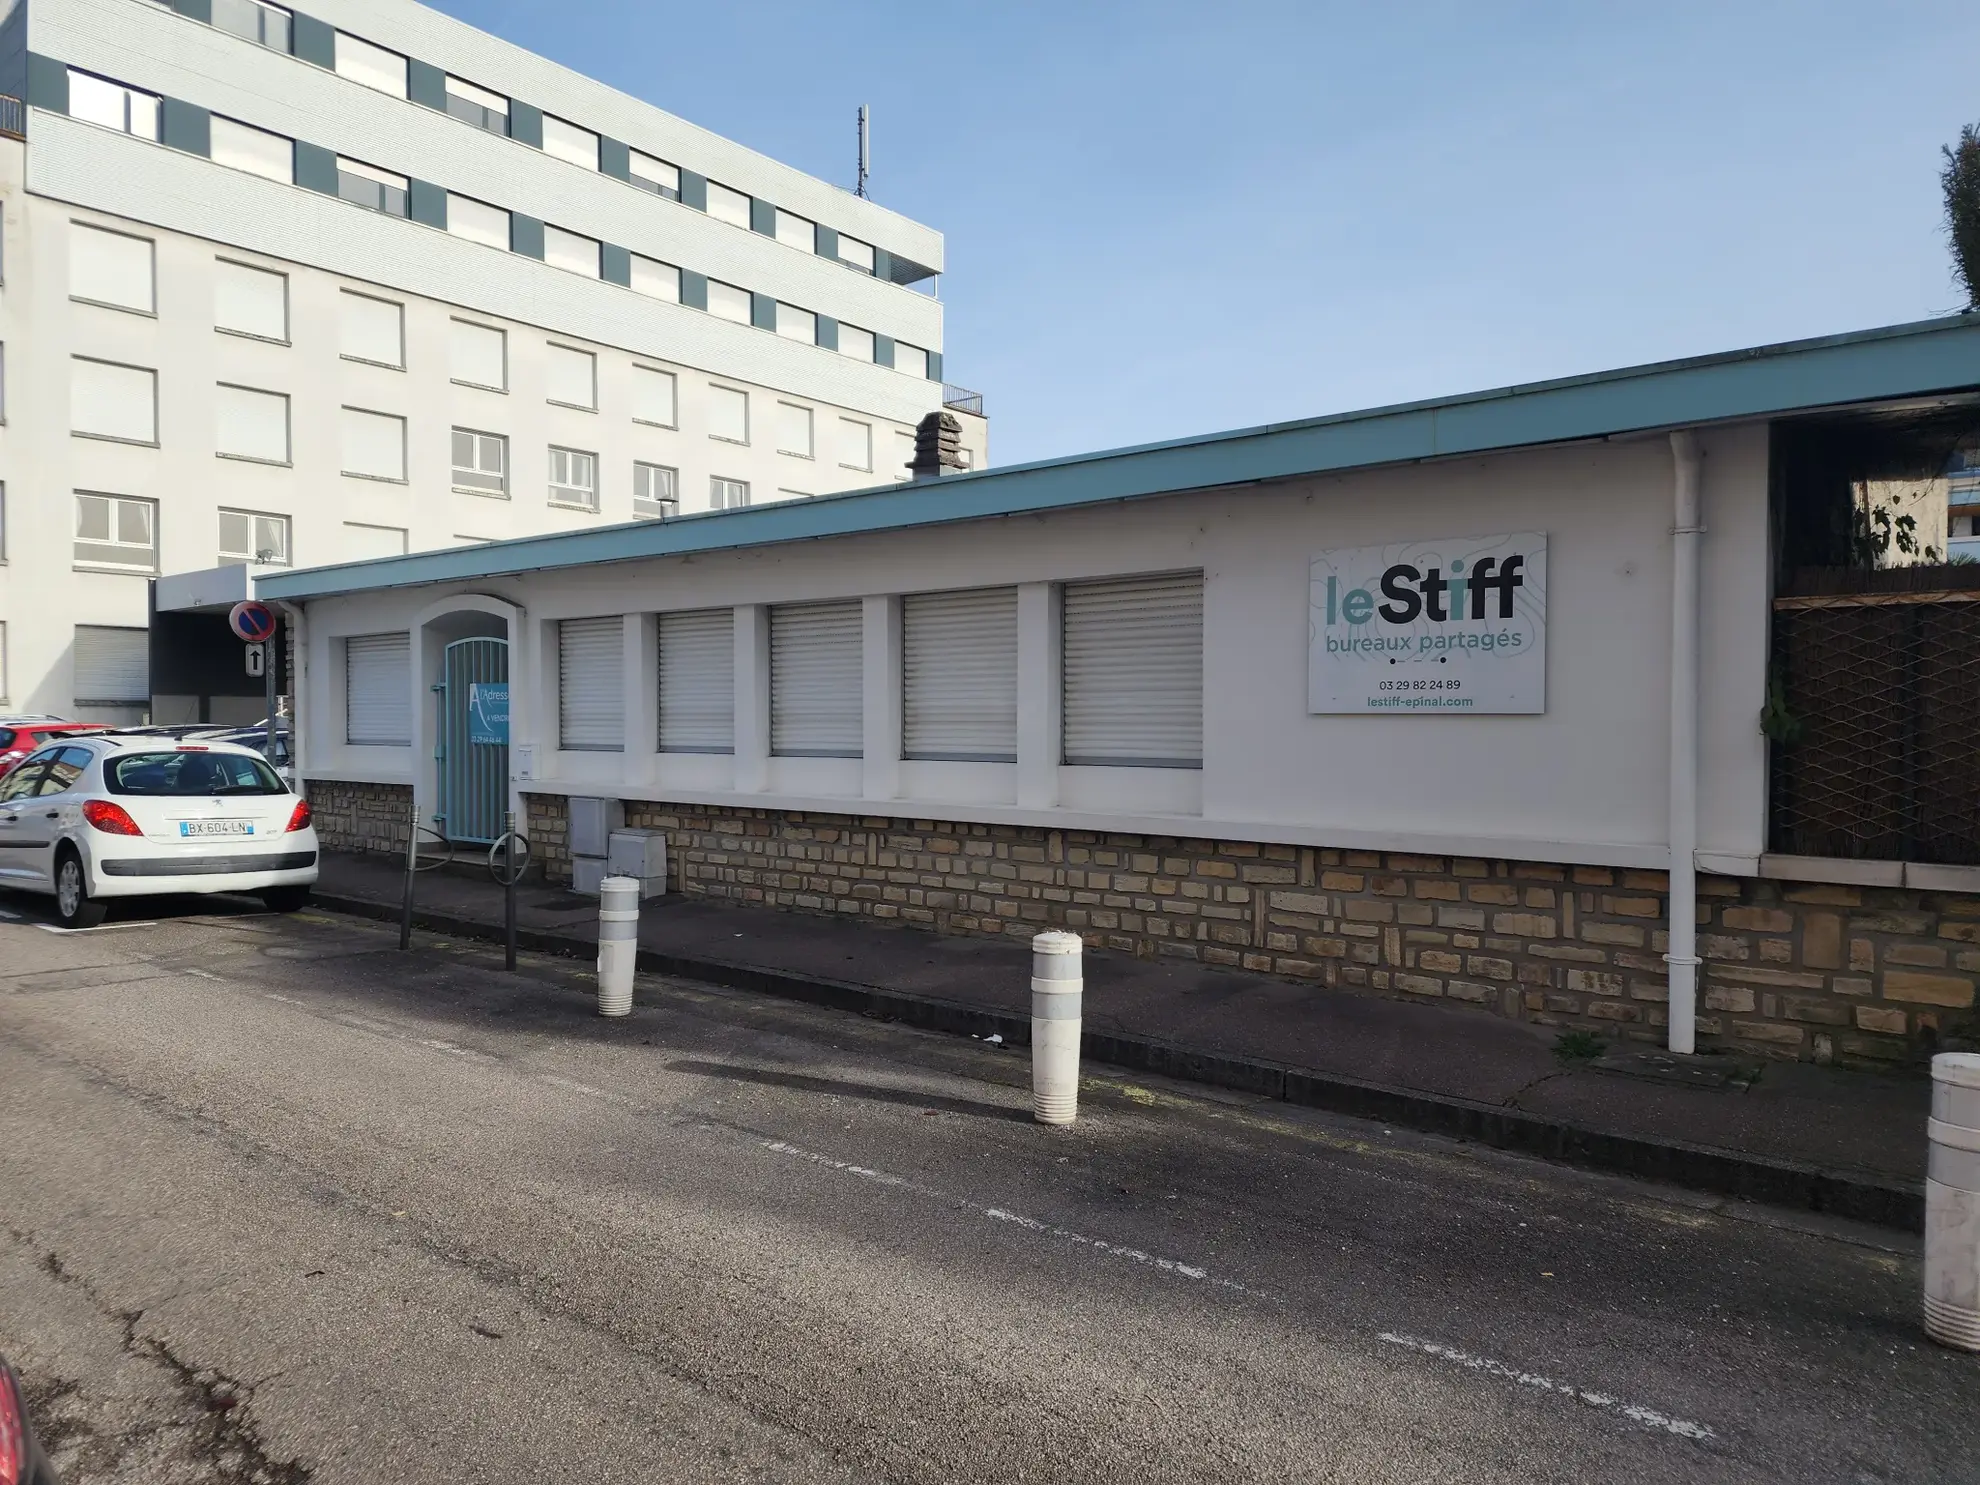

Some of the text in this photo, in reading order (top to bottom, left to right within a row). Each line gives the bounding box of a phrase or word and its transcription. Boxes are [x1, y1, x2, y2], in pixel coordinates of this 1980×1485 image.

[1326, 555, 1524, 625] leStiff
[1326, 628, 1522, 653] bureaux partagés
[1379, 679, 1461, 691] 03 29 82 24 89
[1367, 696, 1473, 709] lestiff-epinal.com
